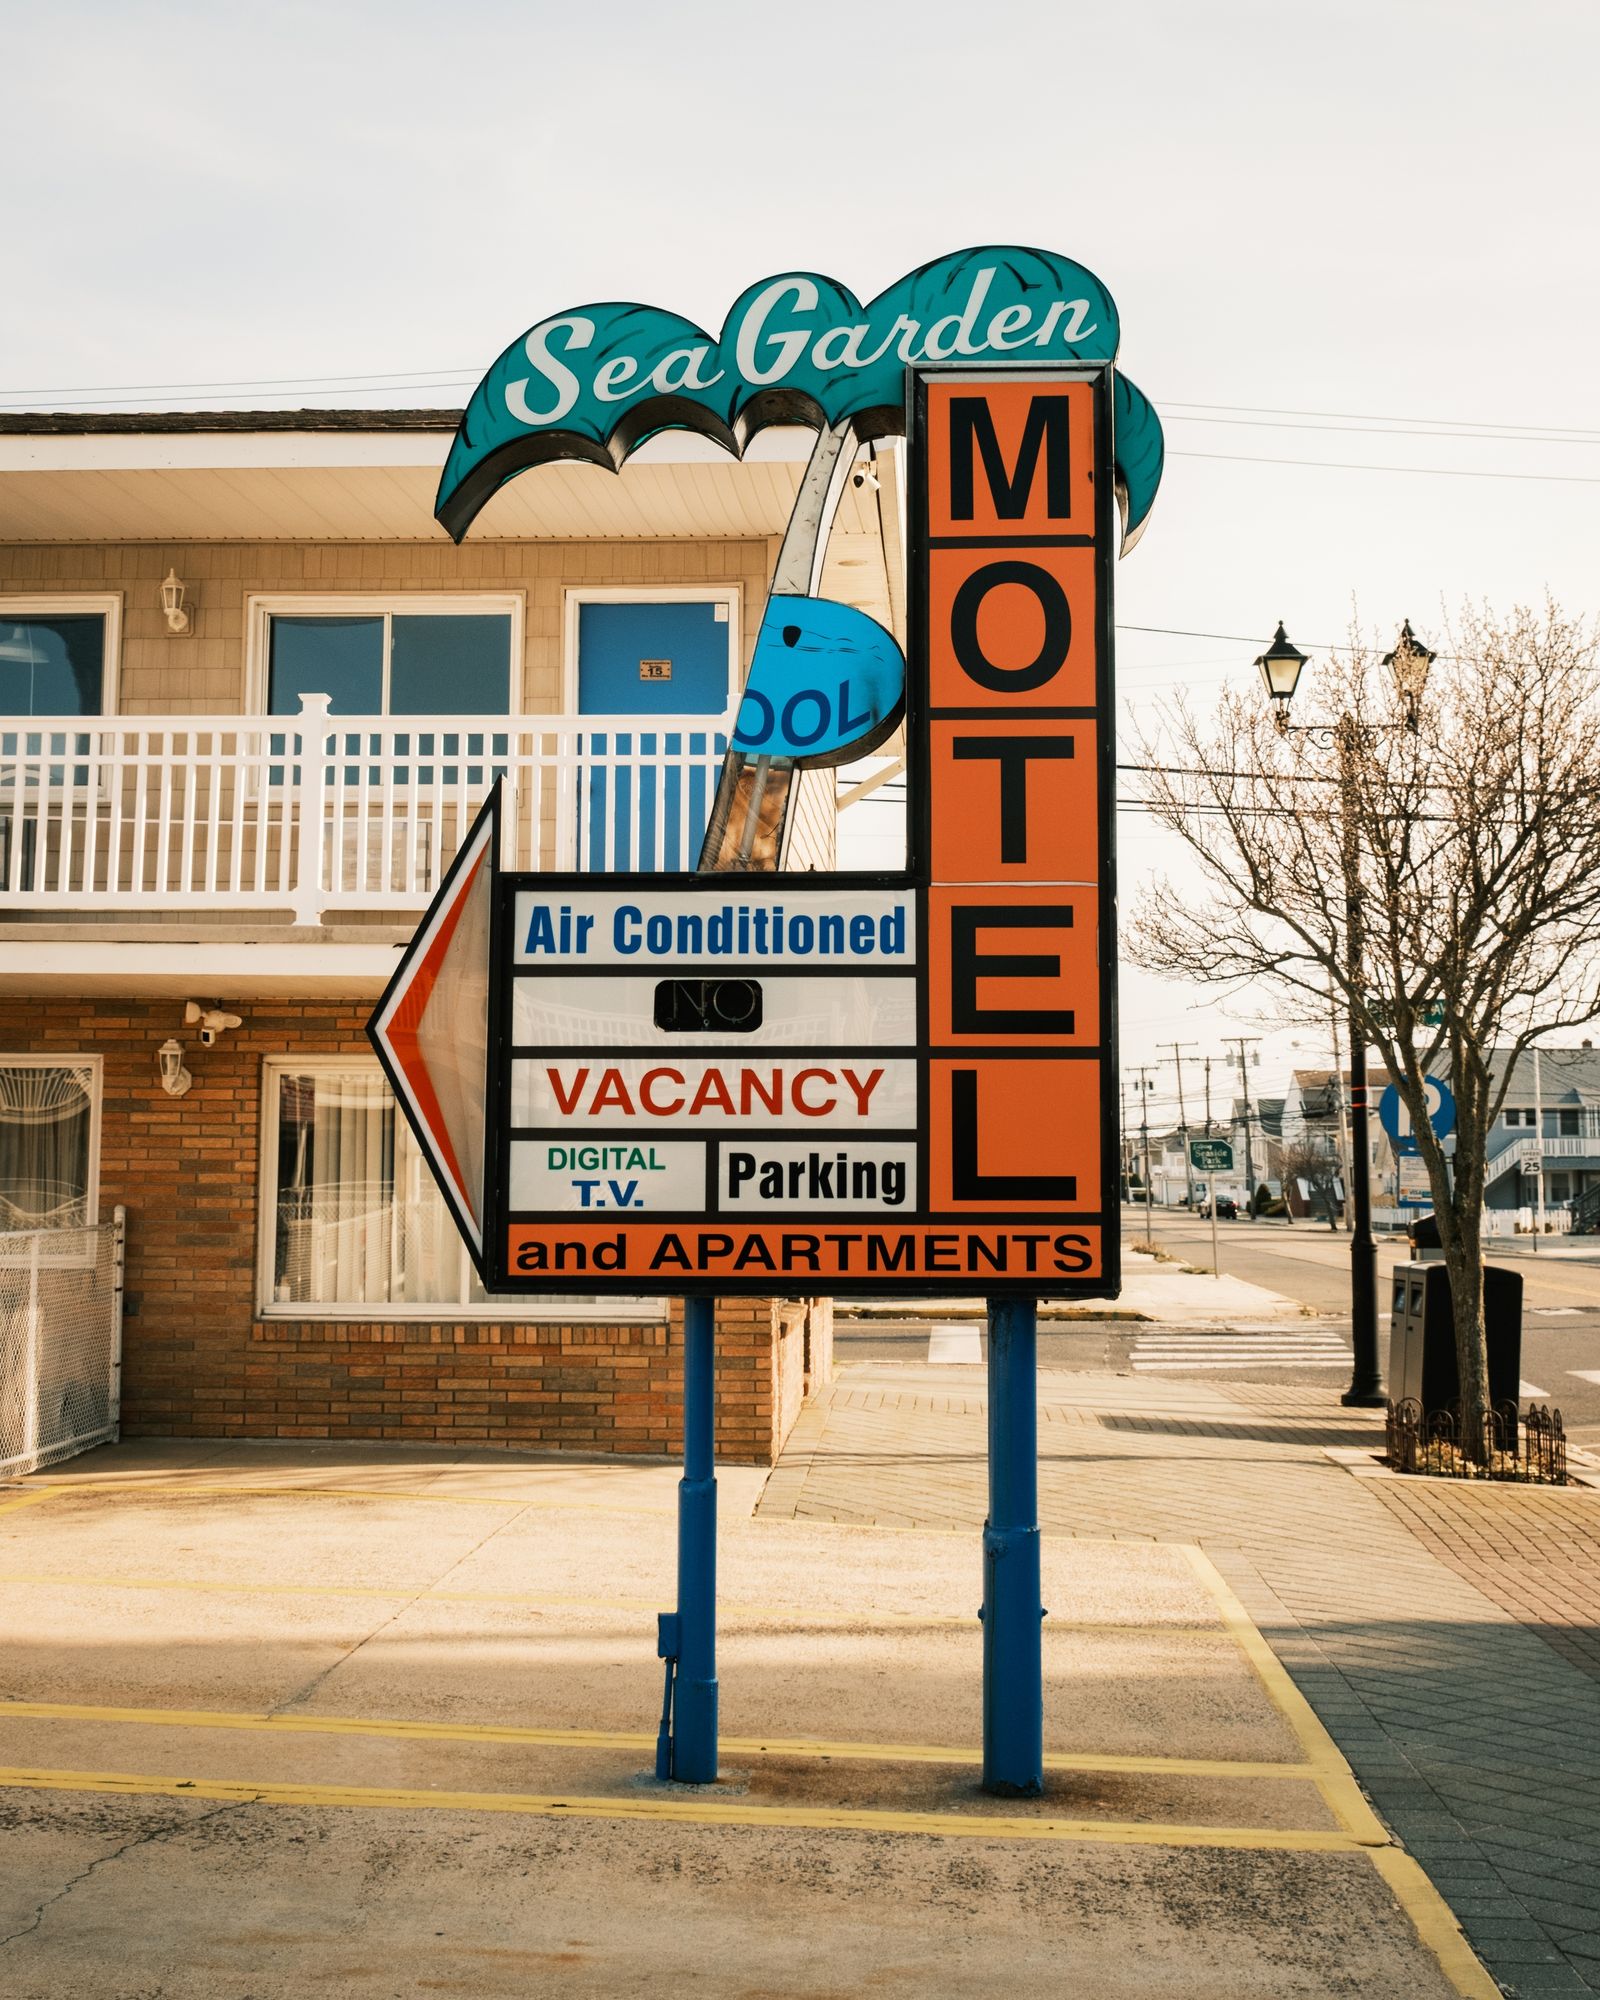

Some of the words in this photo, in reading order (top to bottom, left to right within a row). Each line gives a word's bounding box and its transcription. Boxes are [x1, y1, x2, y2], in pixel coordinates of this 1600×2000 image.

[505, 317, 725, 425] Sea
[736, 267, 1097, 385] Garden
[949, 395, 1078, 1201] MOTEL
[525, 905, 594, 954] Air
[613, 905, 905, 955] Conditioned
[672, 980, 757, 1022] NO
[545, 1067, 886, 1117] VACANCY
[548, 1147, 666, 1171] DIGITAL
[728, 1152, 906, 1206] Parking
[1524, 1162, 1540, 1172] 25
[572, 1180, 644, 1207] T.V.
[516, 1234, 627, 1271] and
[649, 1233, 1093, 1272] APARTMENTS
